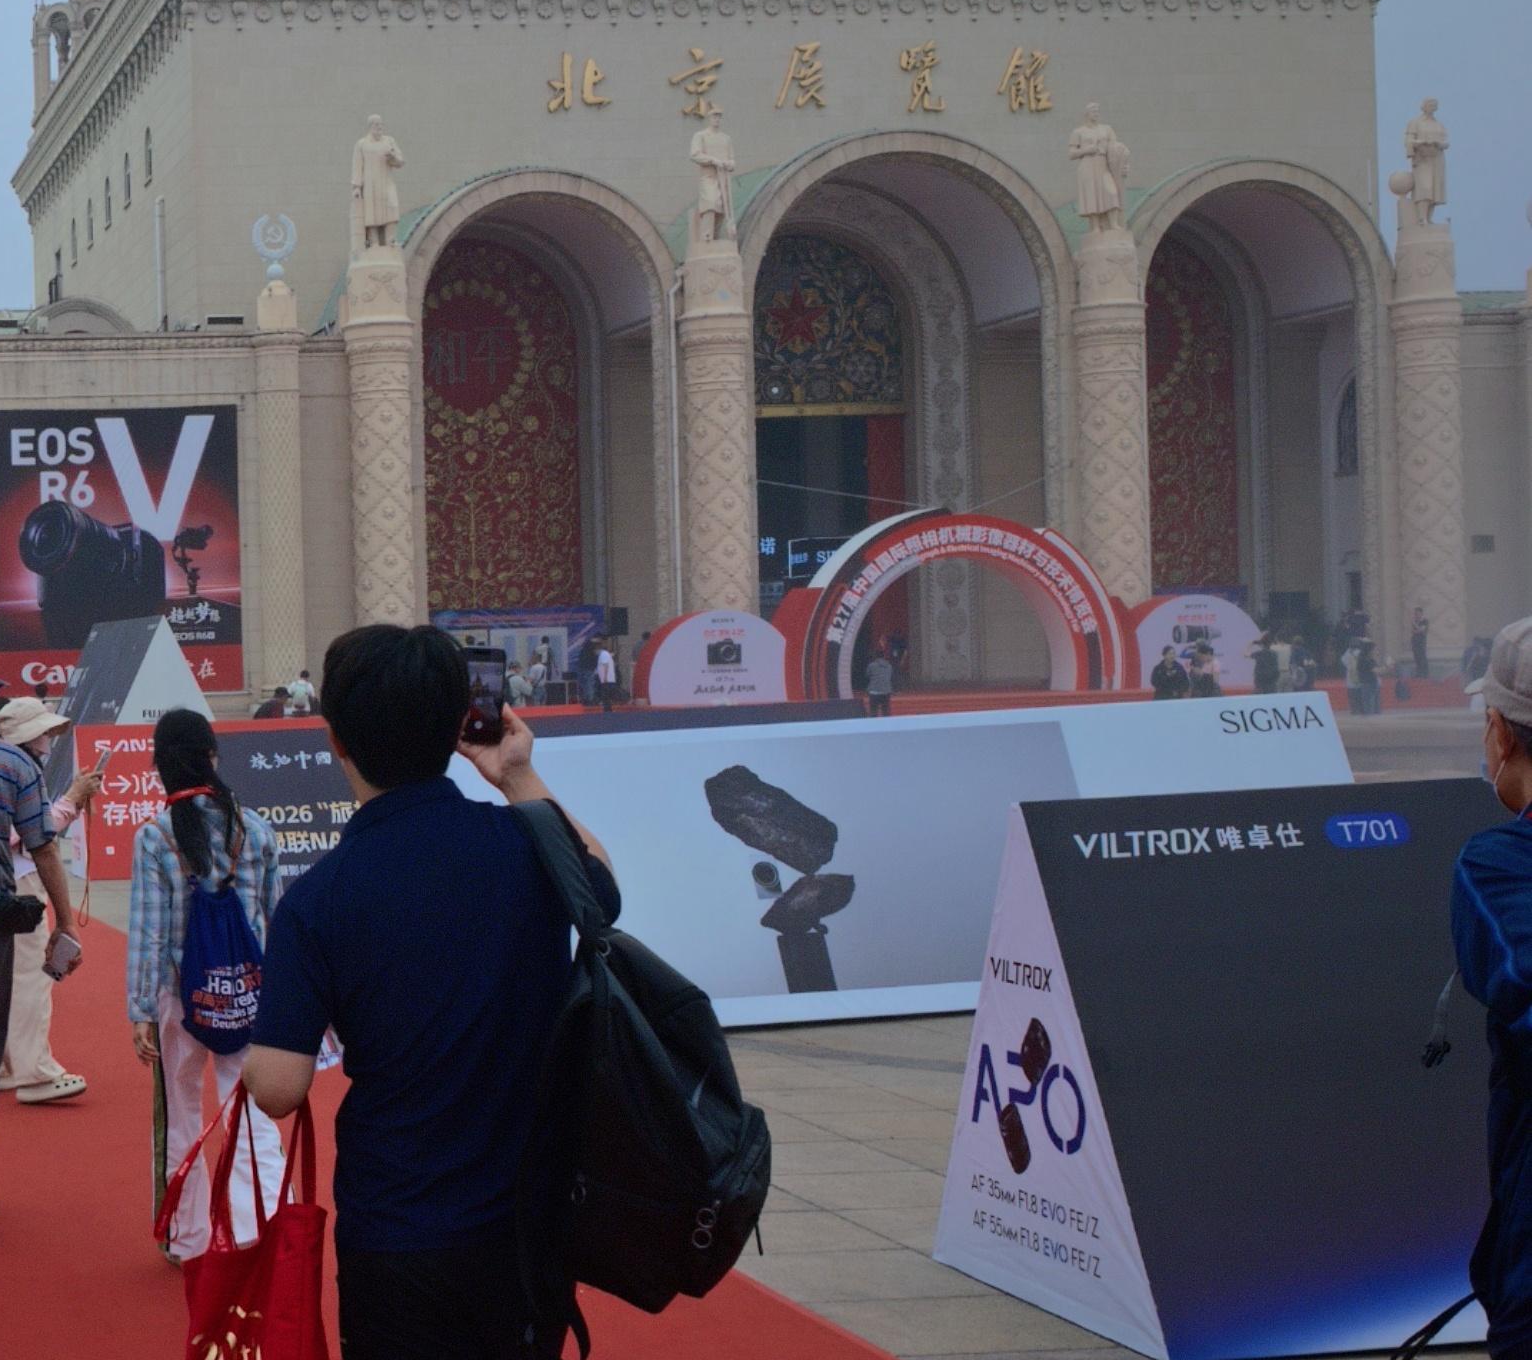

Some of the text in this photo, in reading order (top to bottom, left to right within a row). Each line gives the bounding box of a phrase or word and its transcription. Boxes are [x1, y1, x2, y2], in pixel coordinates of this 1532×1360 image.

[11, 427, 95, 466] EOS
[40, 470, 95, 509] R6
[94, 415, 216, 542] V
[1220, 705, 1324, 734] SIGMA
[1073, 818, 1399, 859] VILTROX 唯卓仕 T701
[990, 956, 1053, 992] VILTROX
[971, 1174, 985, 1192] AF
[1041, 1198, 1067, 1224] EVO
[1069, 1208, 1100, 1239] FE/Z
[973, 1209, 987, 1230] AF
[1043, 1237, 1068, 1264] EVO
[1071, 1247, 1102, 1279] FE/Z
